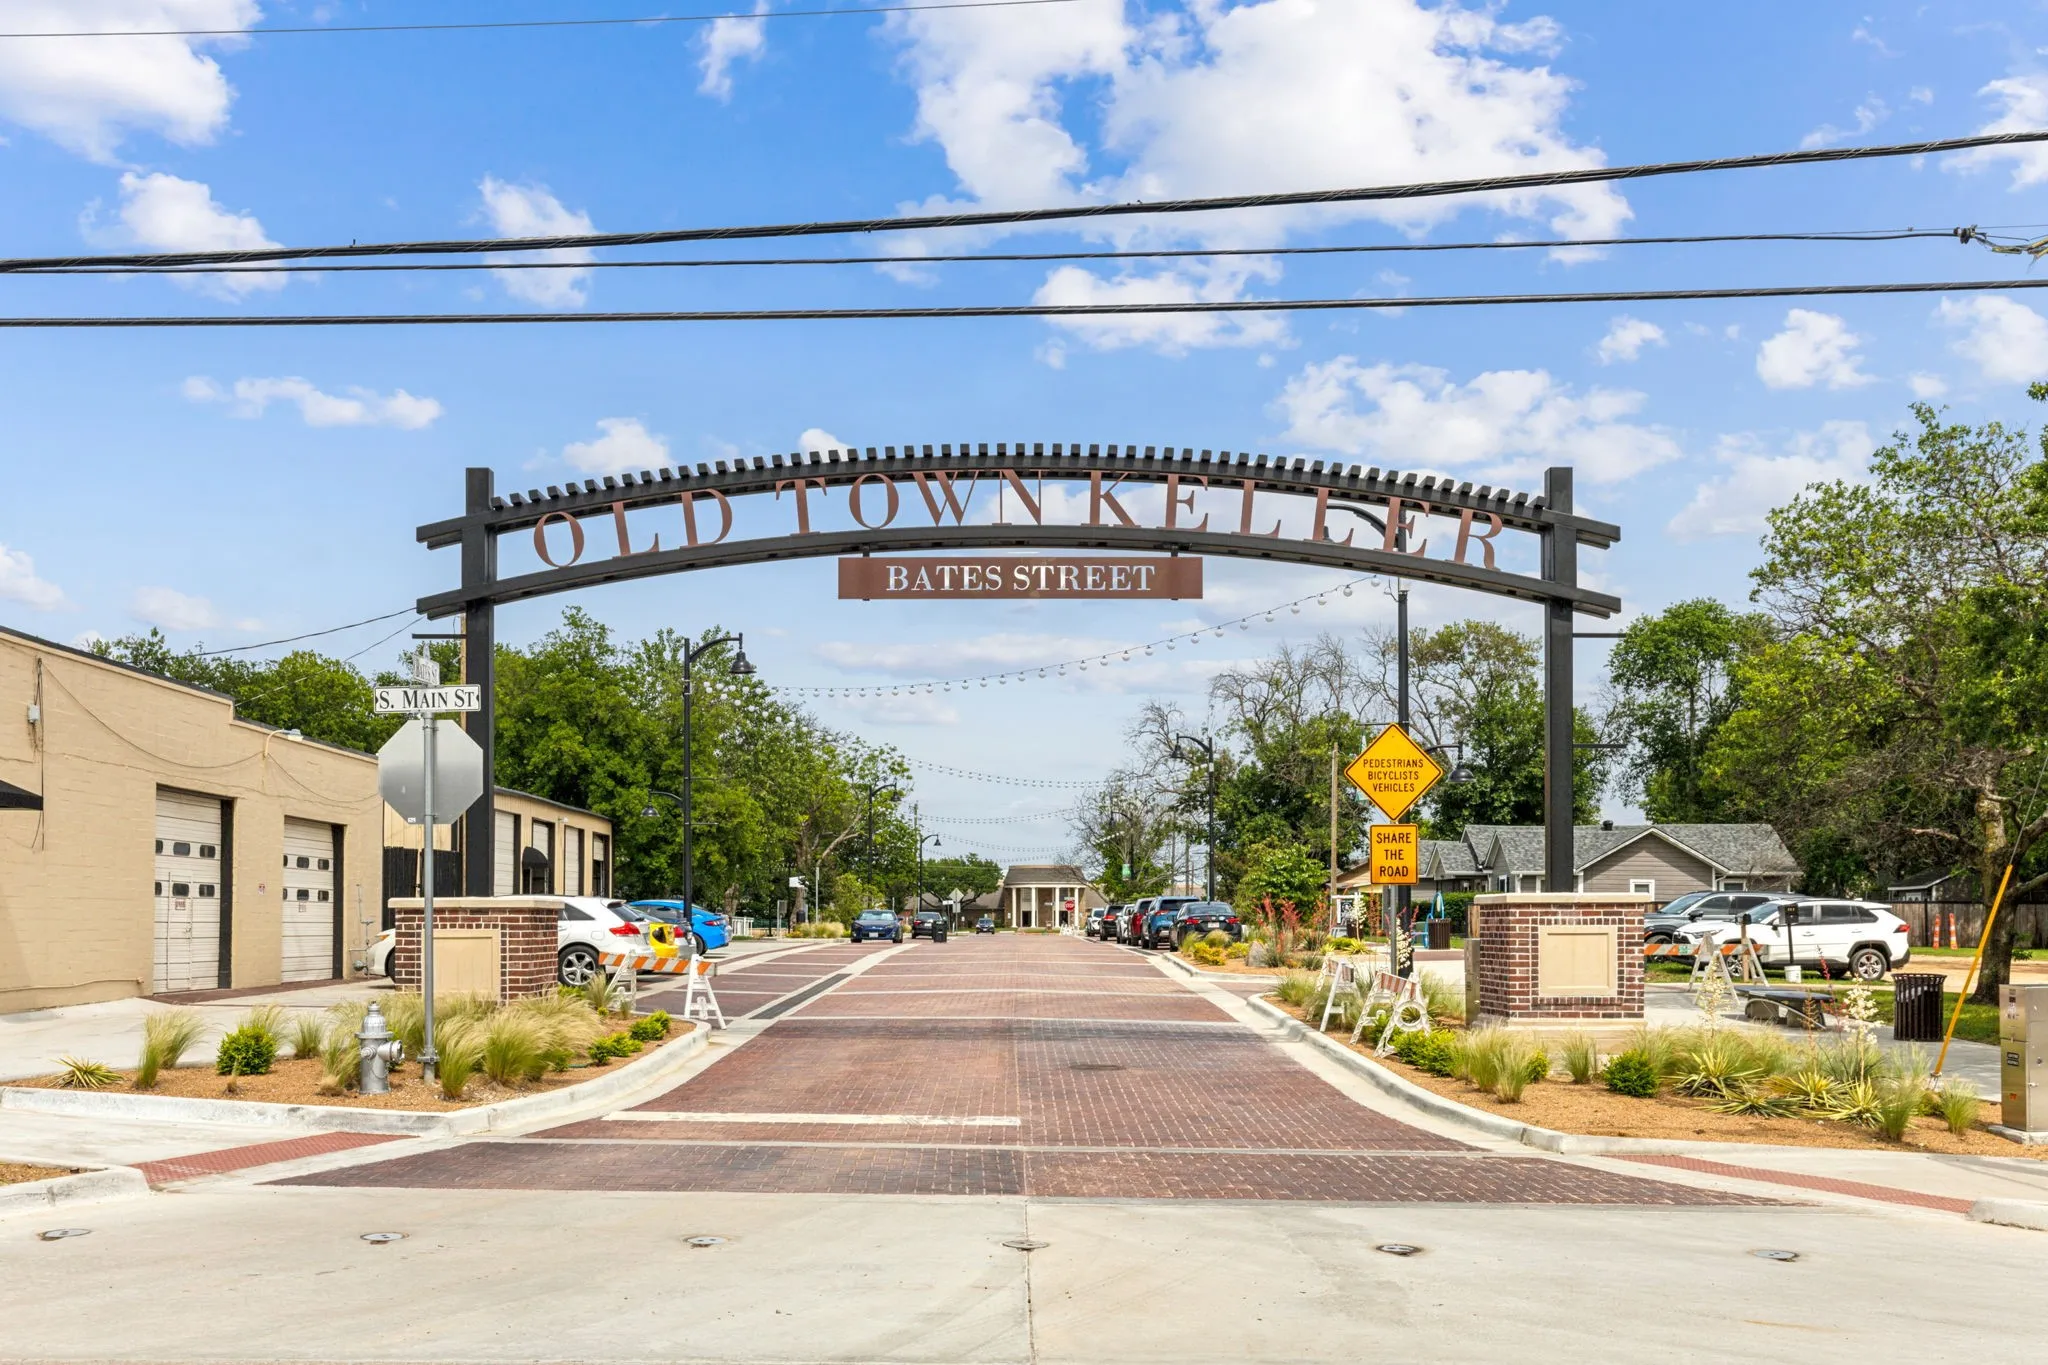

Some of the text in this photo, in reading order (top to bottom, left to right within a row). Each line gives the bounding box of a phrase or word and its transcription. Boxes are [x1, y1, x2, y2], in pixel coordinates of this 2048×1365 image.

[533, 468, 1503, 571] OLD TOWN KELLER
[886, 565, 1155, 591] BATES STREET
[379, 688, 474, 709] S. MAIN ST
[1363, 759, 1424, 768] PEDESTRIANS
[1368, 771, 1419, 780] BICYCLISTS
[1372, 783, 1415, 792] VEHICLES
[1376, 832, 1412, 844] SHARE
[1384, 849, 1404, 860] THE
[1379, 866, 1409, 877] ROAD
